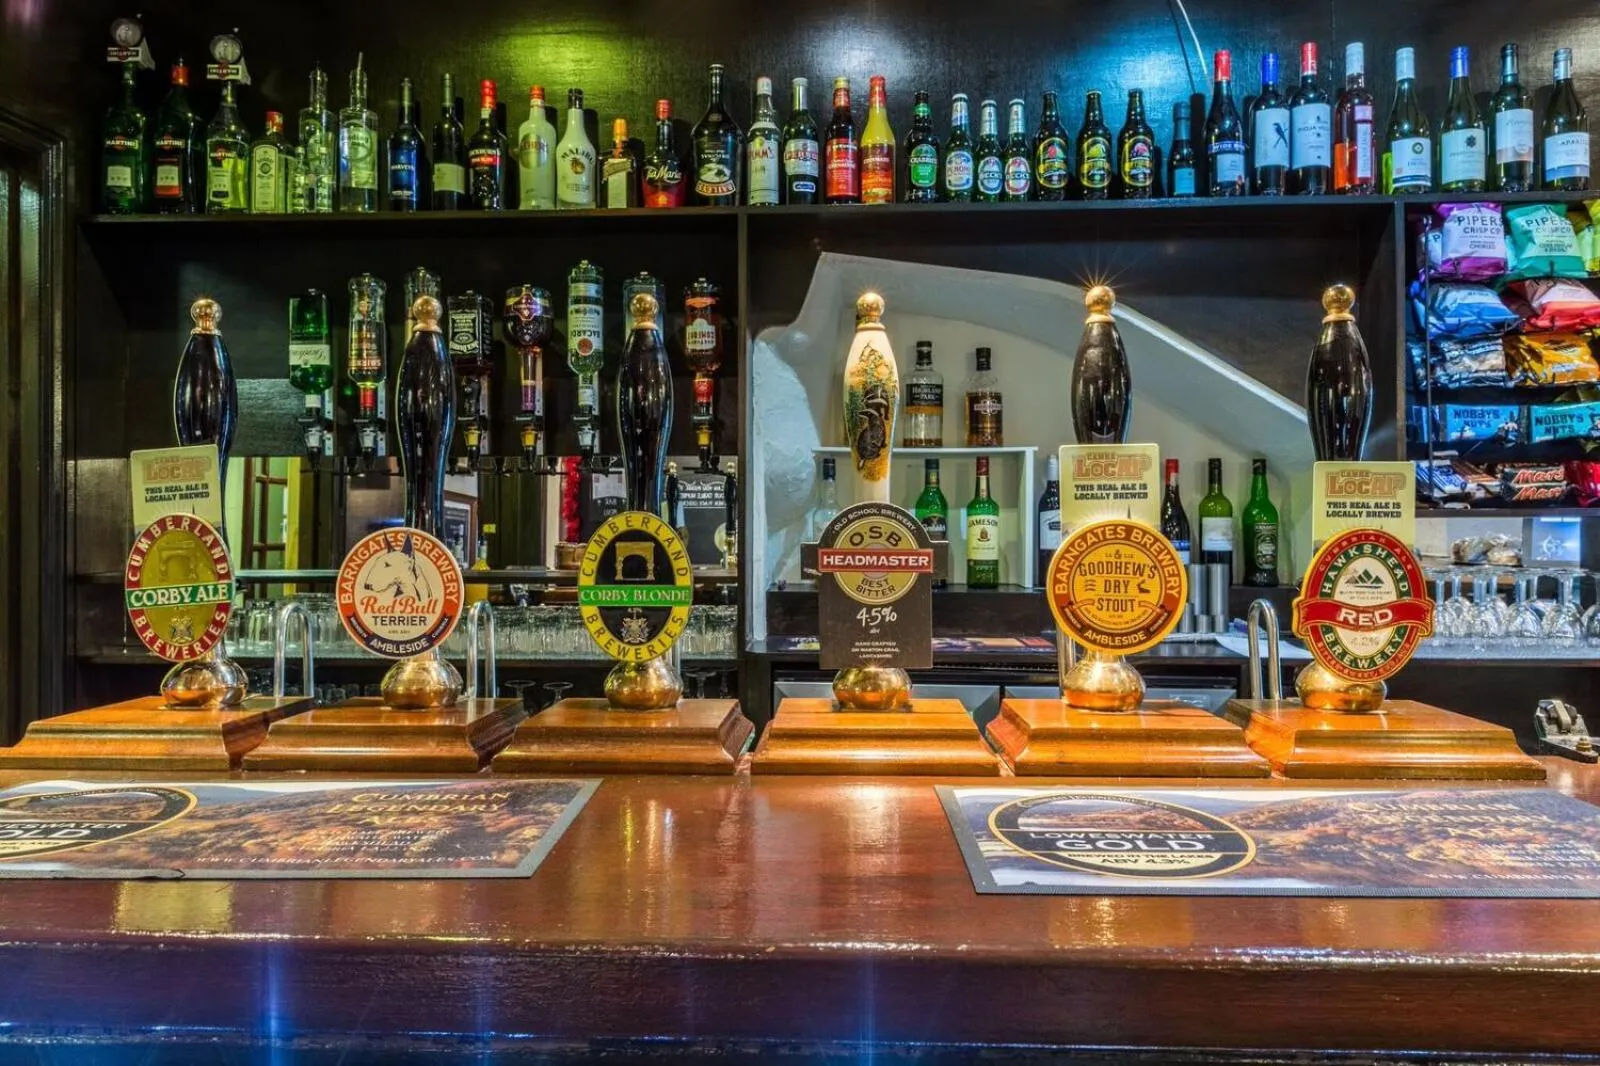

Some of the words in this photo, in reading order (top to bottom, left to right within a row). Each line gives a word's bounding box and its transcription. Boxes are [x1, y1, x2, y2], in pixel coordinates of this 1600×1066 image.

[145, 494, 177, 503] LOCALLY
[834, 518, 848, 531] OLD
[848, 508, 879, 520] SCHOOL
[881, 508, 917, 531] BREWERY
[1326, 510, 1363, 518] LOCALLY
[128, 516, 229, 582] CUMBERLAND
[582, 515, 688, 577] CUMBERLAND
[342, 532, 406, 605] BARNGATES
[413, 533, 459, 603] BREWERY
[823, 555, 930, 567] HEADMASTER
[1055, 525, 1126, 595] BARNGATES
[1130, 528, 1180, 598] BREWERY
[1322, 544, 1409, 593] HAWKSHEAD
[1079, 561, 1157, 580] GOODHEW'S
[861, 578, 889, 587] BEST
[1104, 579, 1130, 594] DRY
[131, 587, 193, 607] CORBY
[196, 584, 229, 601] ALE
[580, 589, 631, 601] CORBY
[633, 589, 689, 601] BLONDE
[856, 585, 897, 597] BITTER
[360, 595, 399, 615] Red
[398, 595, 439, 615] Bull
[1096, 597, 1136, 613] STOUT
[372, 616, 427, 626] TERRIER
[856, 606, 897, 627] 4.5%
[1339, 608, 1393, 626] RED
[134, 611, 227, 660] BREWERIES
[586, 614, 684, 660] BREWERIES
[1084, 630, 1147, 646] AMBLESIDE
[369, 638, 430, 654] AMBLESIDE
[1324, 631, 1403, 669] BREWERY
[352, 792, 512, 803] CUMBRIAN
[327, 803, 508, 814] LEGENDARY
[1029, 832, 1216, 840] LOWESWATER
[1055, 839, 1207, 851] GOLD
[1100, 857, 1140, 865] ABV
[1144, 857, 1191, 865] 4.3%
